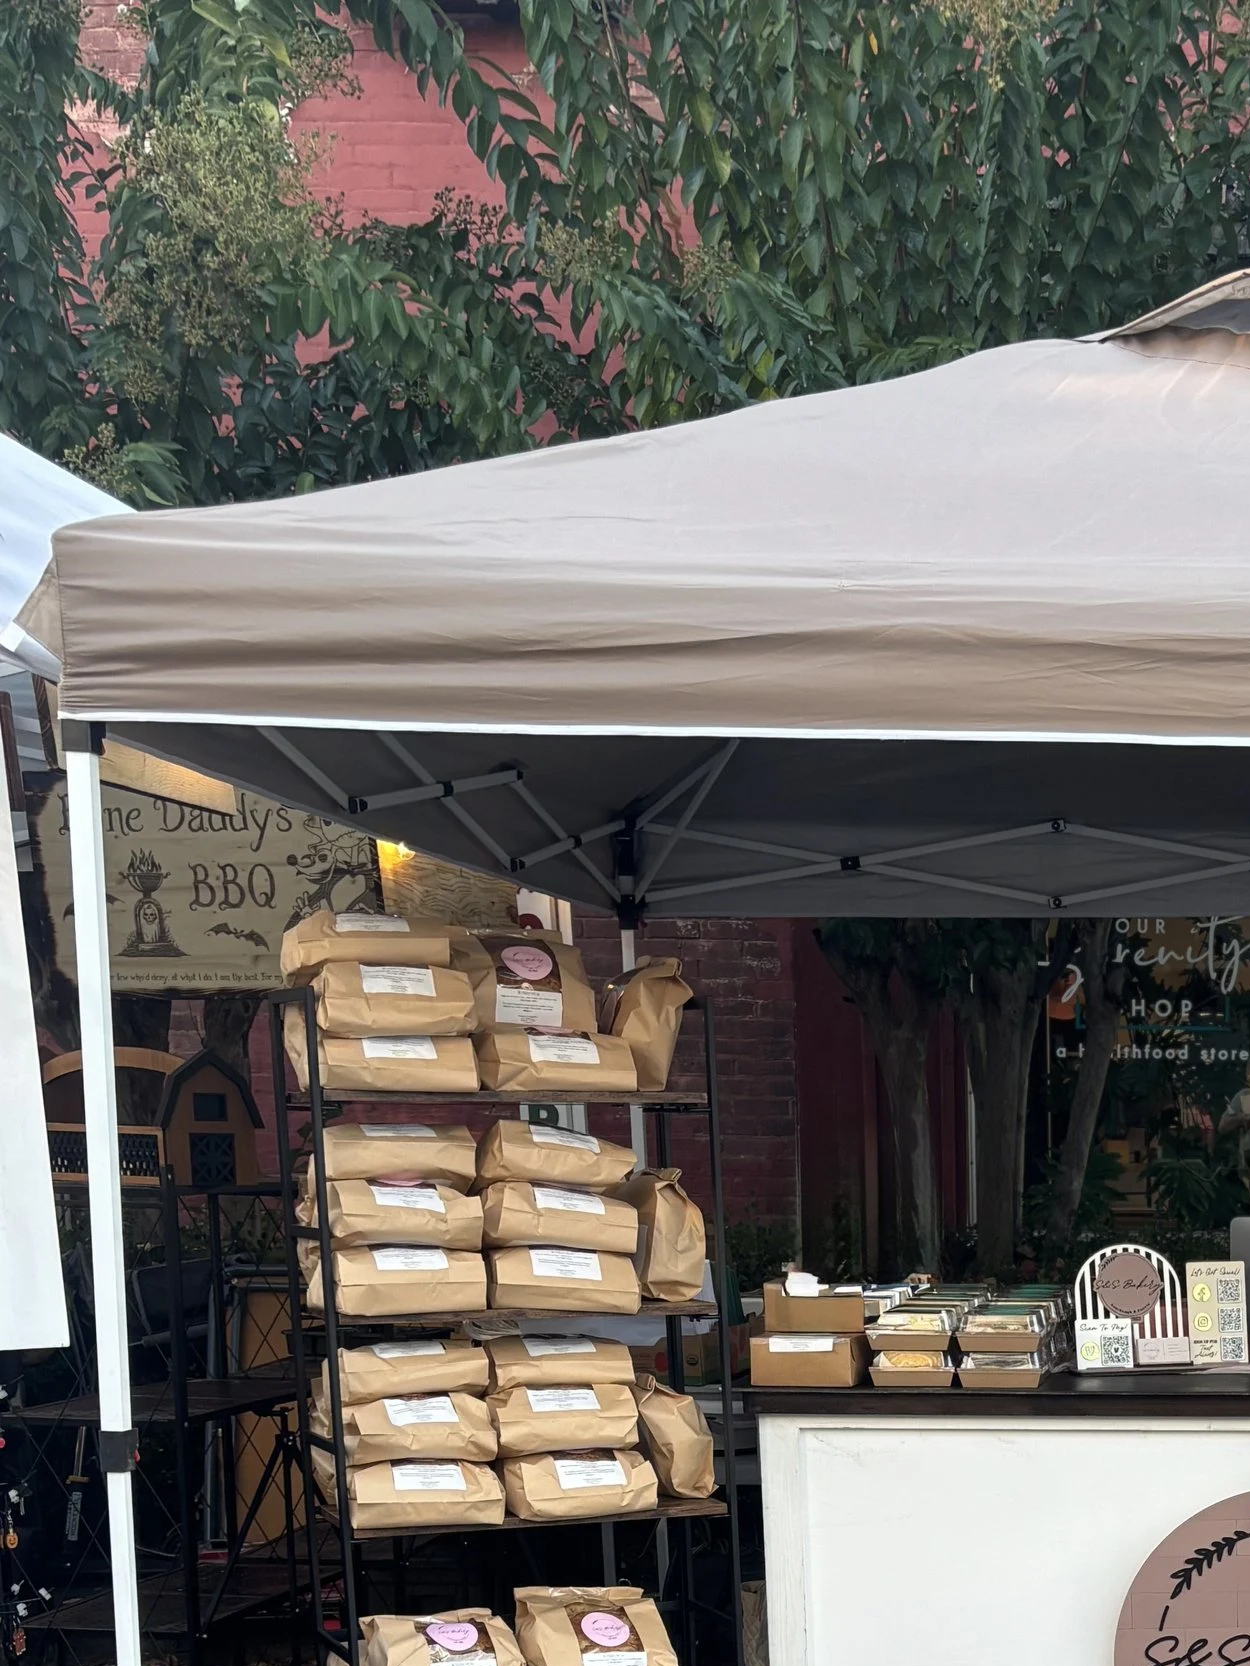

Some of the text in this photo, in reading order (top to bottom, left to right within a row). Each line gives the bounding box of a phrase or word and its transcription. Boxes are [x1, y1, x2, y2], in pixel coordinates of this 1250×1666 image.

[58, 791, 144, 837] ne
[187, 862, 277, 911] BBQ
[1115, 917, 1167, 935] OUR
[1131, 998, 1194, 1019] HOP
[1055, 1045, 1067, 1058] a
[1200, 1046, 1250, 1061] store
[1095, 1275, 1164, 1297] S&S Bakery
